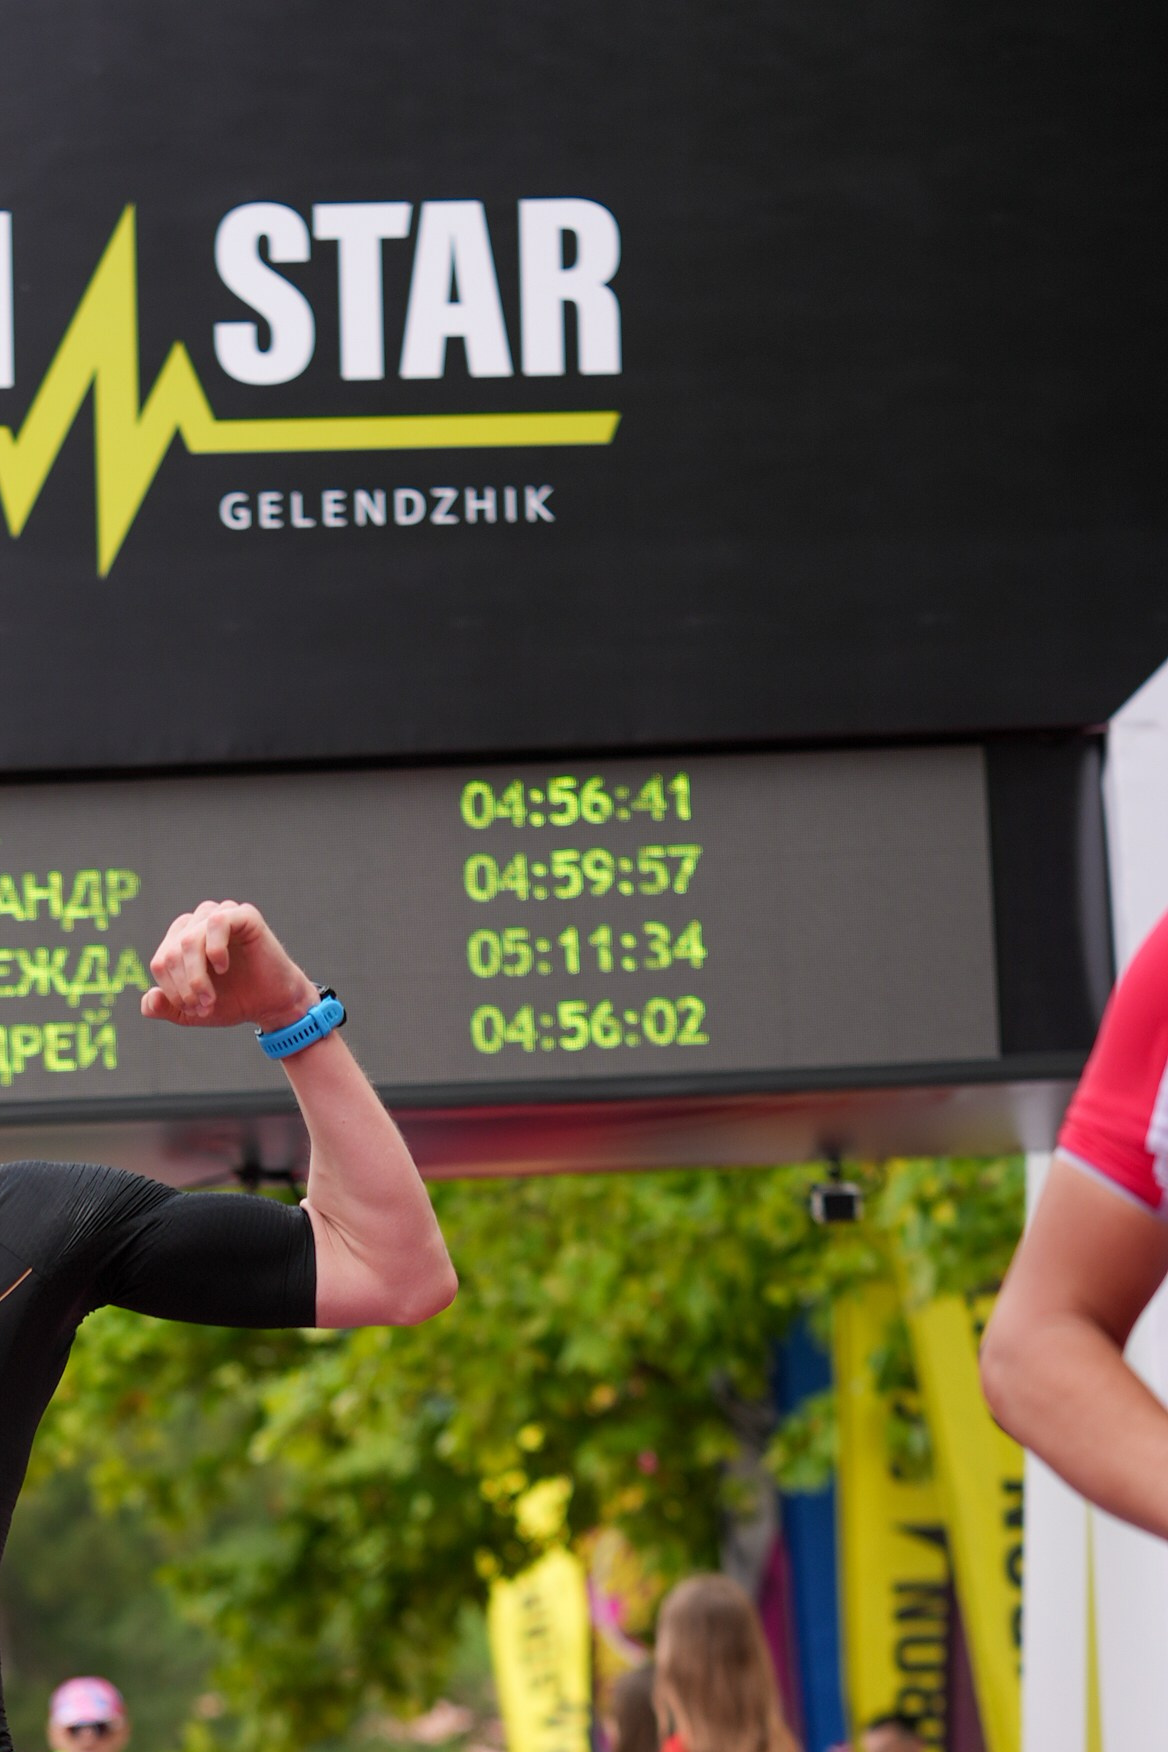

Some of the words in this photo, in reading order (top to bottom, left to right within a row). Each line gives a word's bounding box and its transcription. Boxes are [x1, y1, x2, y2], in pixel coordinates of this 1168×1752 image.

[213, 197, 622, 385] STAR
[219, 485, 556, 530] GELENDZHIK
[460, 773, 693, 829] 04:56:41
[464, 844, 704, 903] 04:59:57
[467, 921, 708, 978] 05:11:34
[471, 996, 710, 1053] 04:56:02
